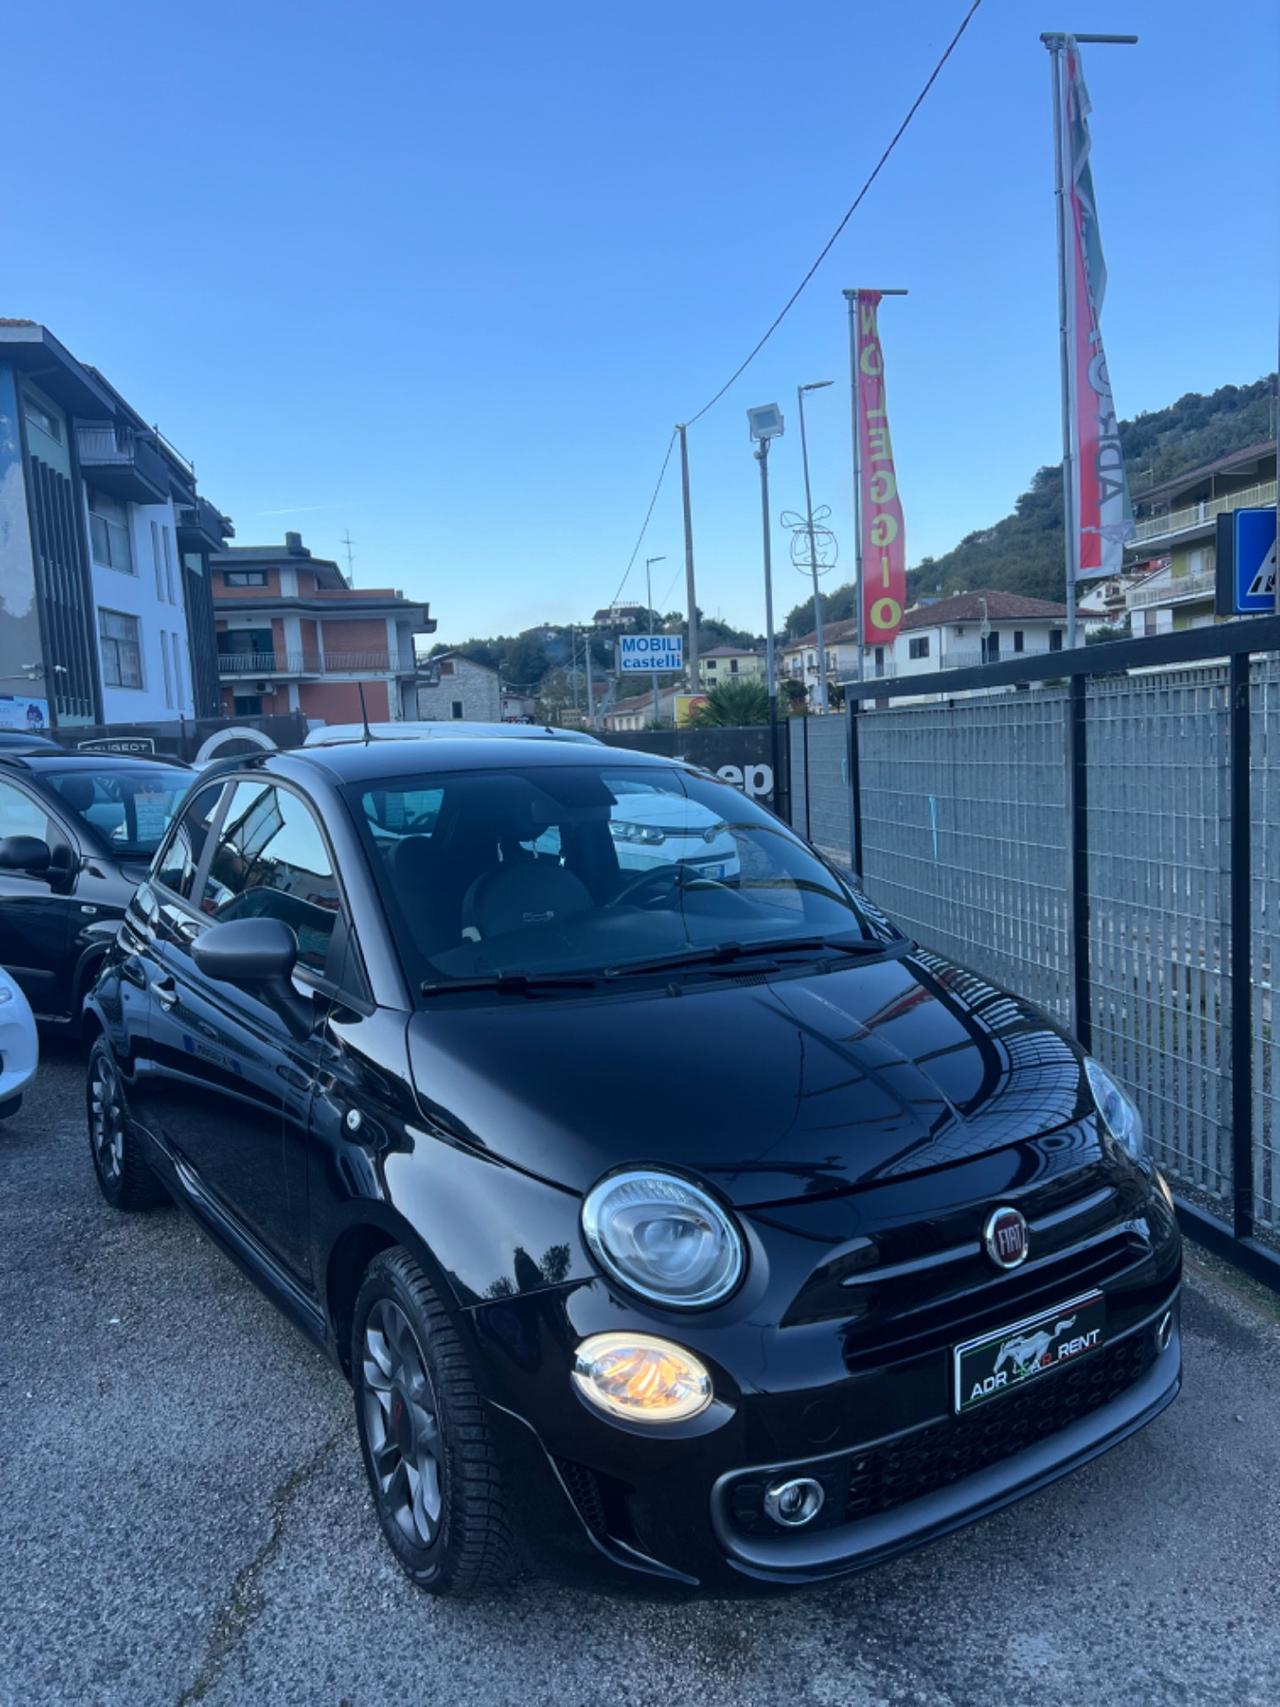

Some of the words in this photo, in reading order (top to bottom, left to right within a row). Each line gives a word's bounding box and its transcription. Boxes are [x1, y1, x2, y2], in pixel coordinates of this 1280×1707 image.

[622, 637, 681, 652] MOBILI
[623, 653, 681, 668] castelli
[997, 1223, 1022, 1256] FIAT
[969, 1371, 1008, 1400] ADR
[1057, 1328, 1101, 1359] RENT
